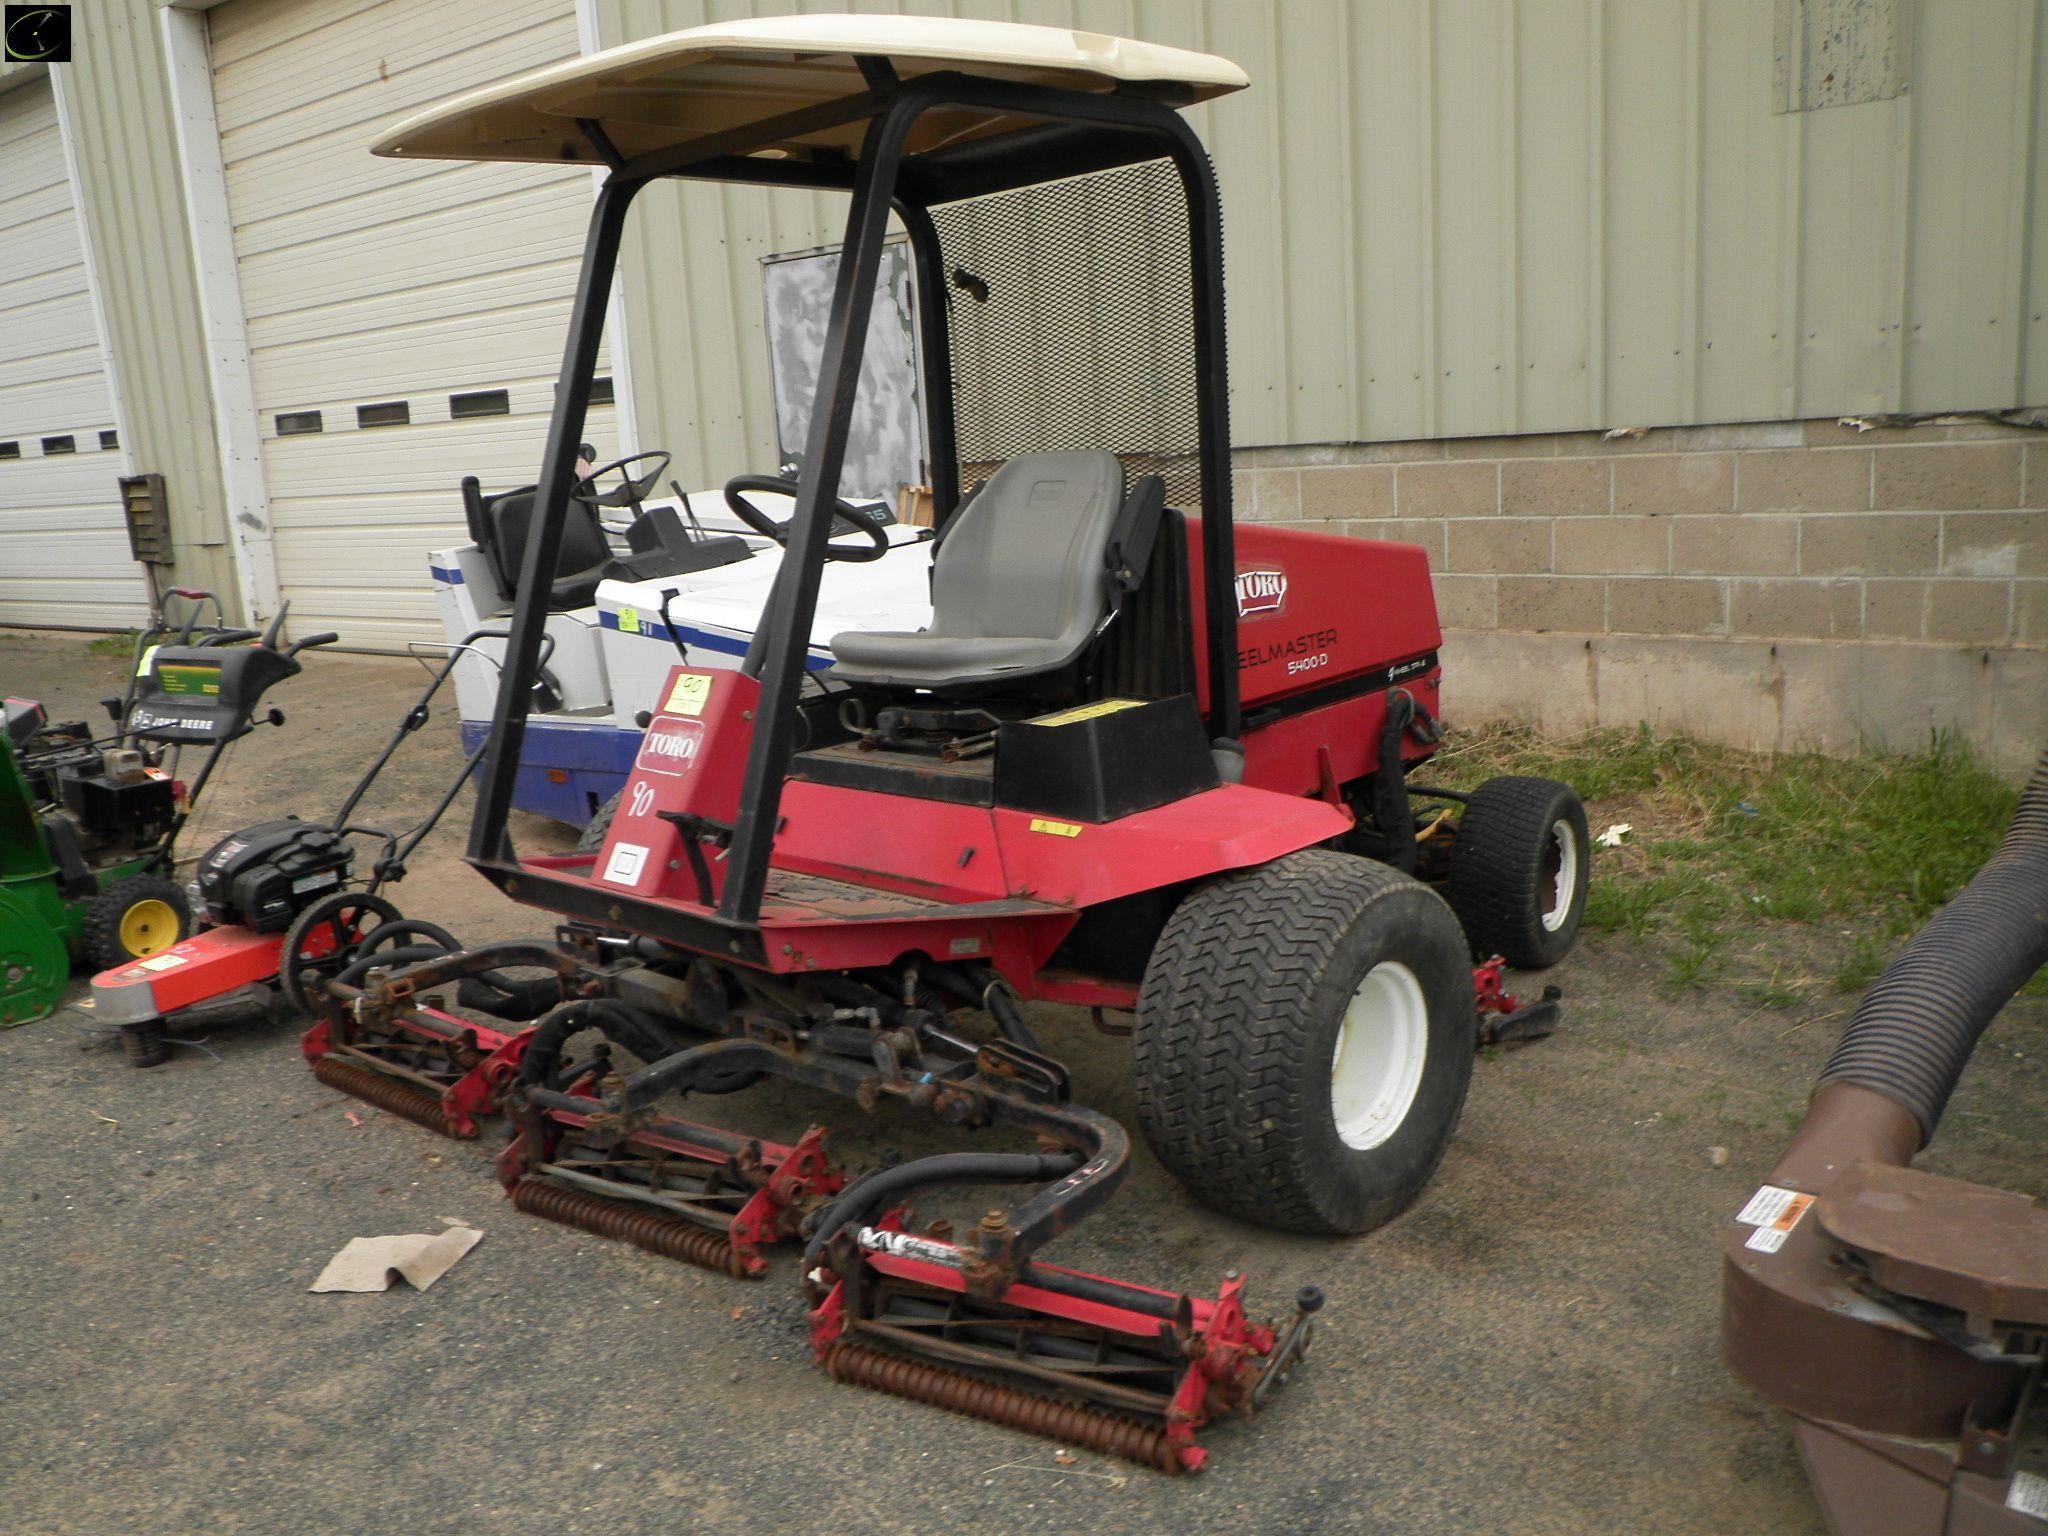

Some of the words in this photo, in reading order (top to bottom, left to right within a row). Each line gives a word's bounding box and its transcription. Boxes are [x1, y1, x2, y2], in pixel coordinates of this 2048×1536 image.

[1238, 573, 1287, 600] TORO
[1238, 628, 1338, 669] EELMASTER
[180, 719, 214, 730] DEERE
[647, 732, 694, 758] TORO
[627, 781, 655, 817] 90
